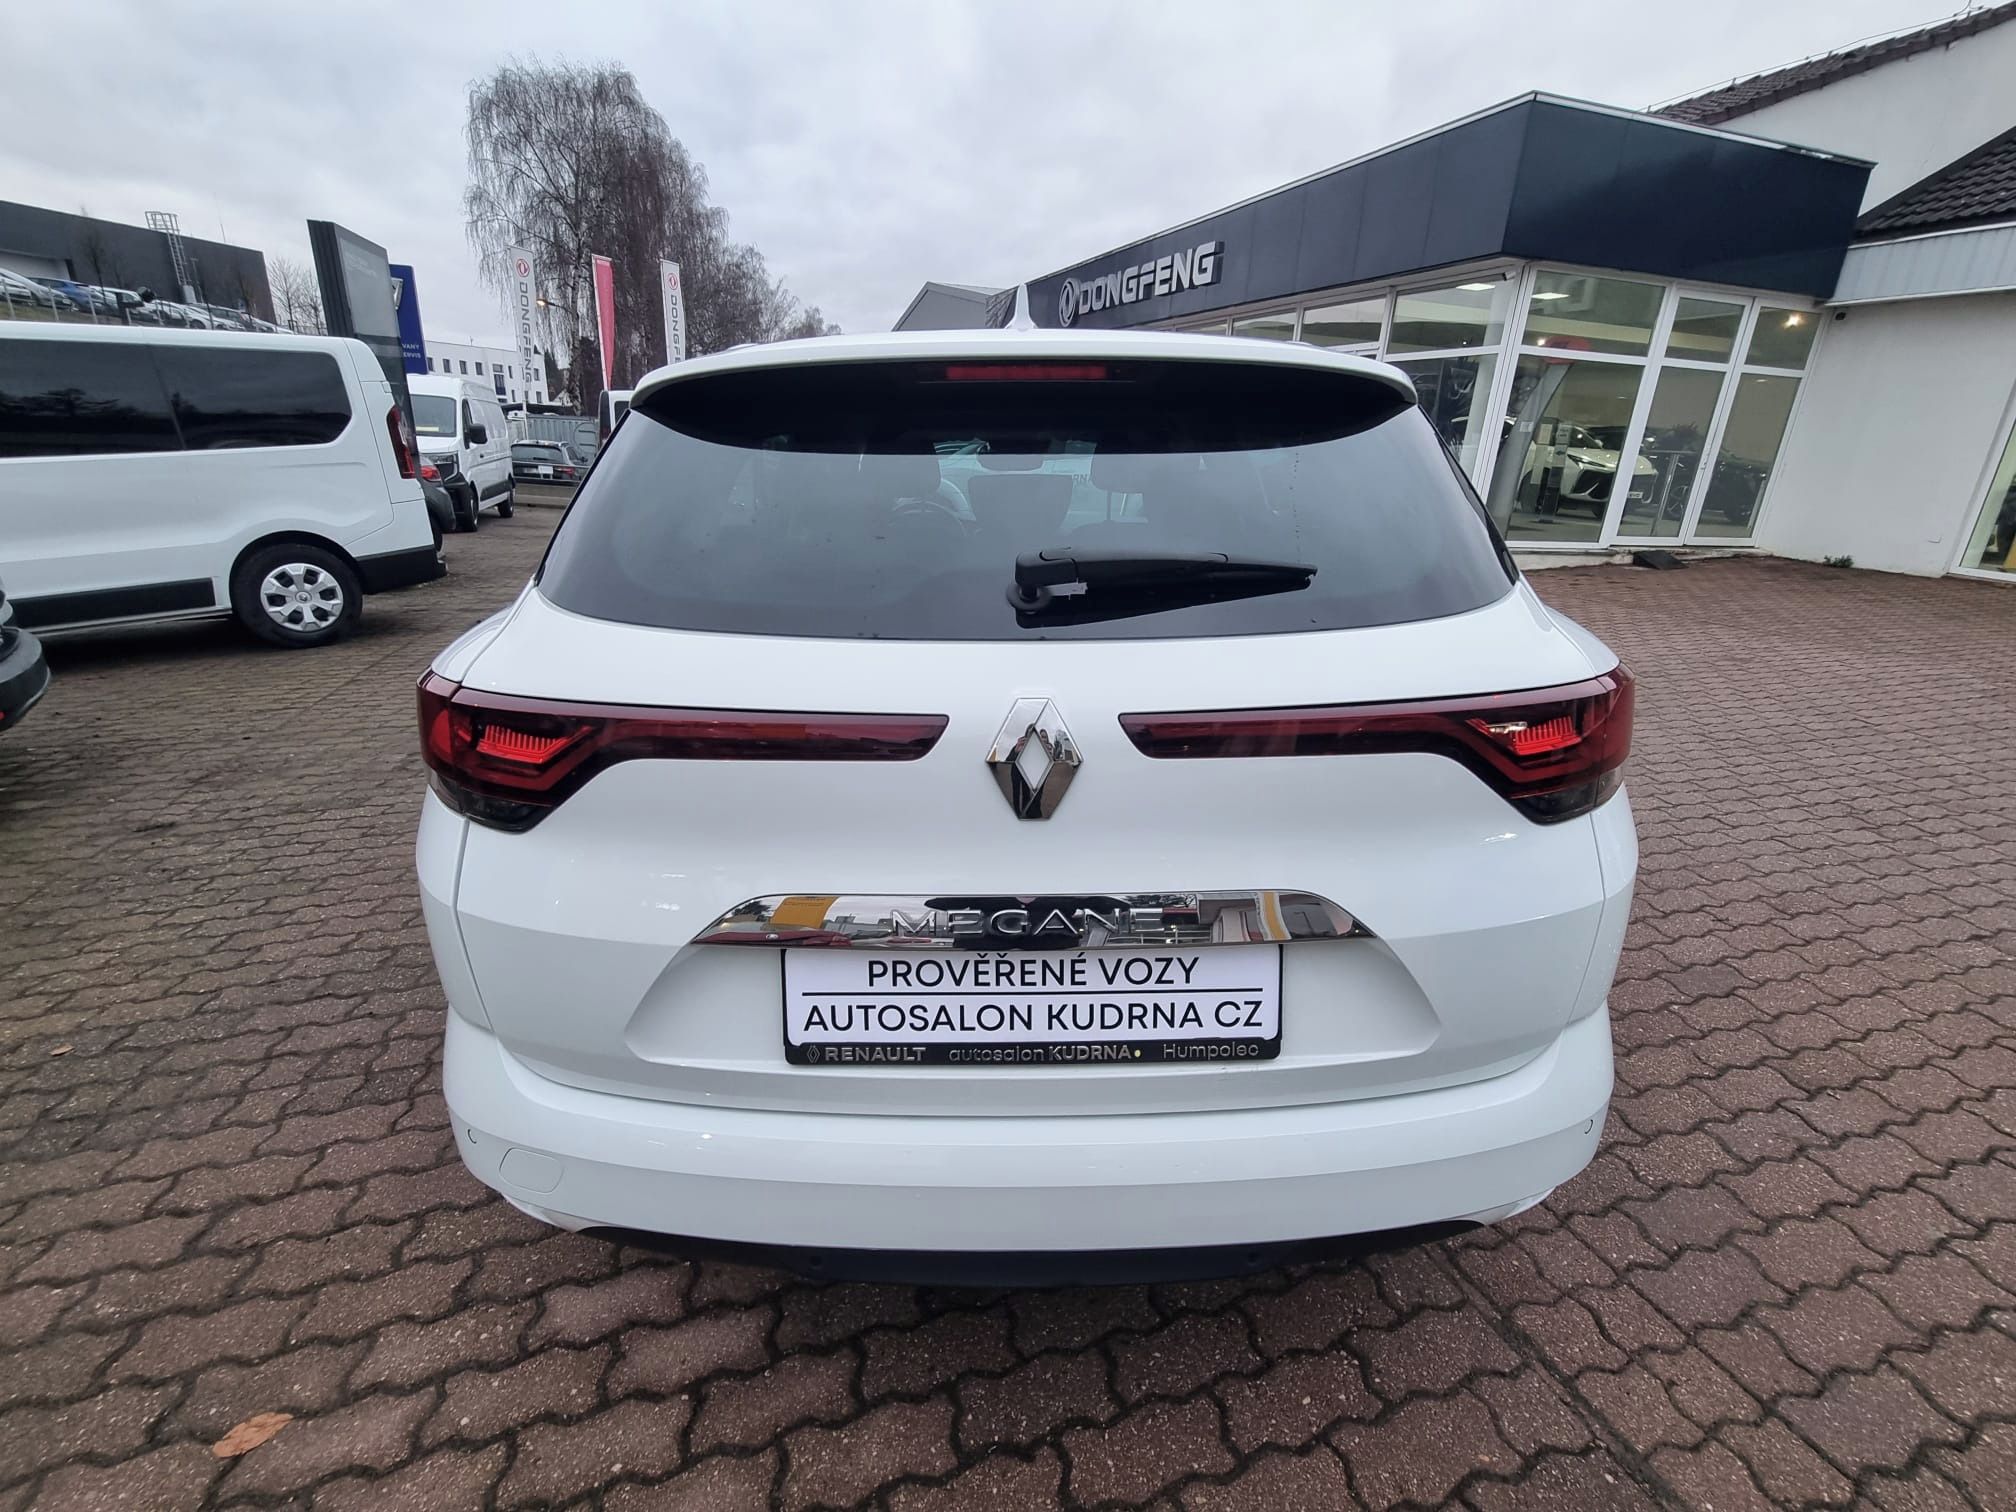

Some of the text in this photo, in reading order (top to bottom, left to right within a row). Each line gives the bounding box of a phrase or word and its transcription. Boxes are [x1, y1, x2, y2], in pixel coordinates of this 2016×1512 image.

[1078, 241, 1221, 315] DONGFENG
[519, 281, 532, 383] DONGFENG
[868, 951, 1200, 987] PROVĚŘENÉ VOZY
[803, 1000, 1263, 1032] AUTOSALON KUDRNA CZ
[825, 1047, 926, 1062] RENAULT
[949, 1045, 1045, 1062] autosalon
[1049, 1045, 1132, 1061] KUDRNA
